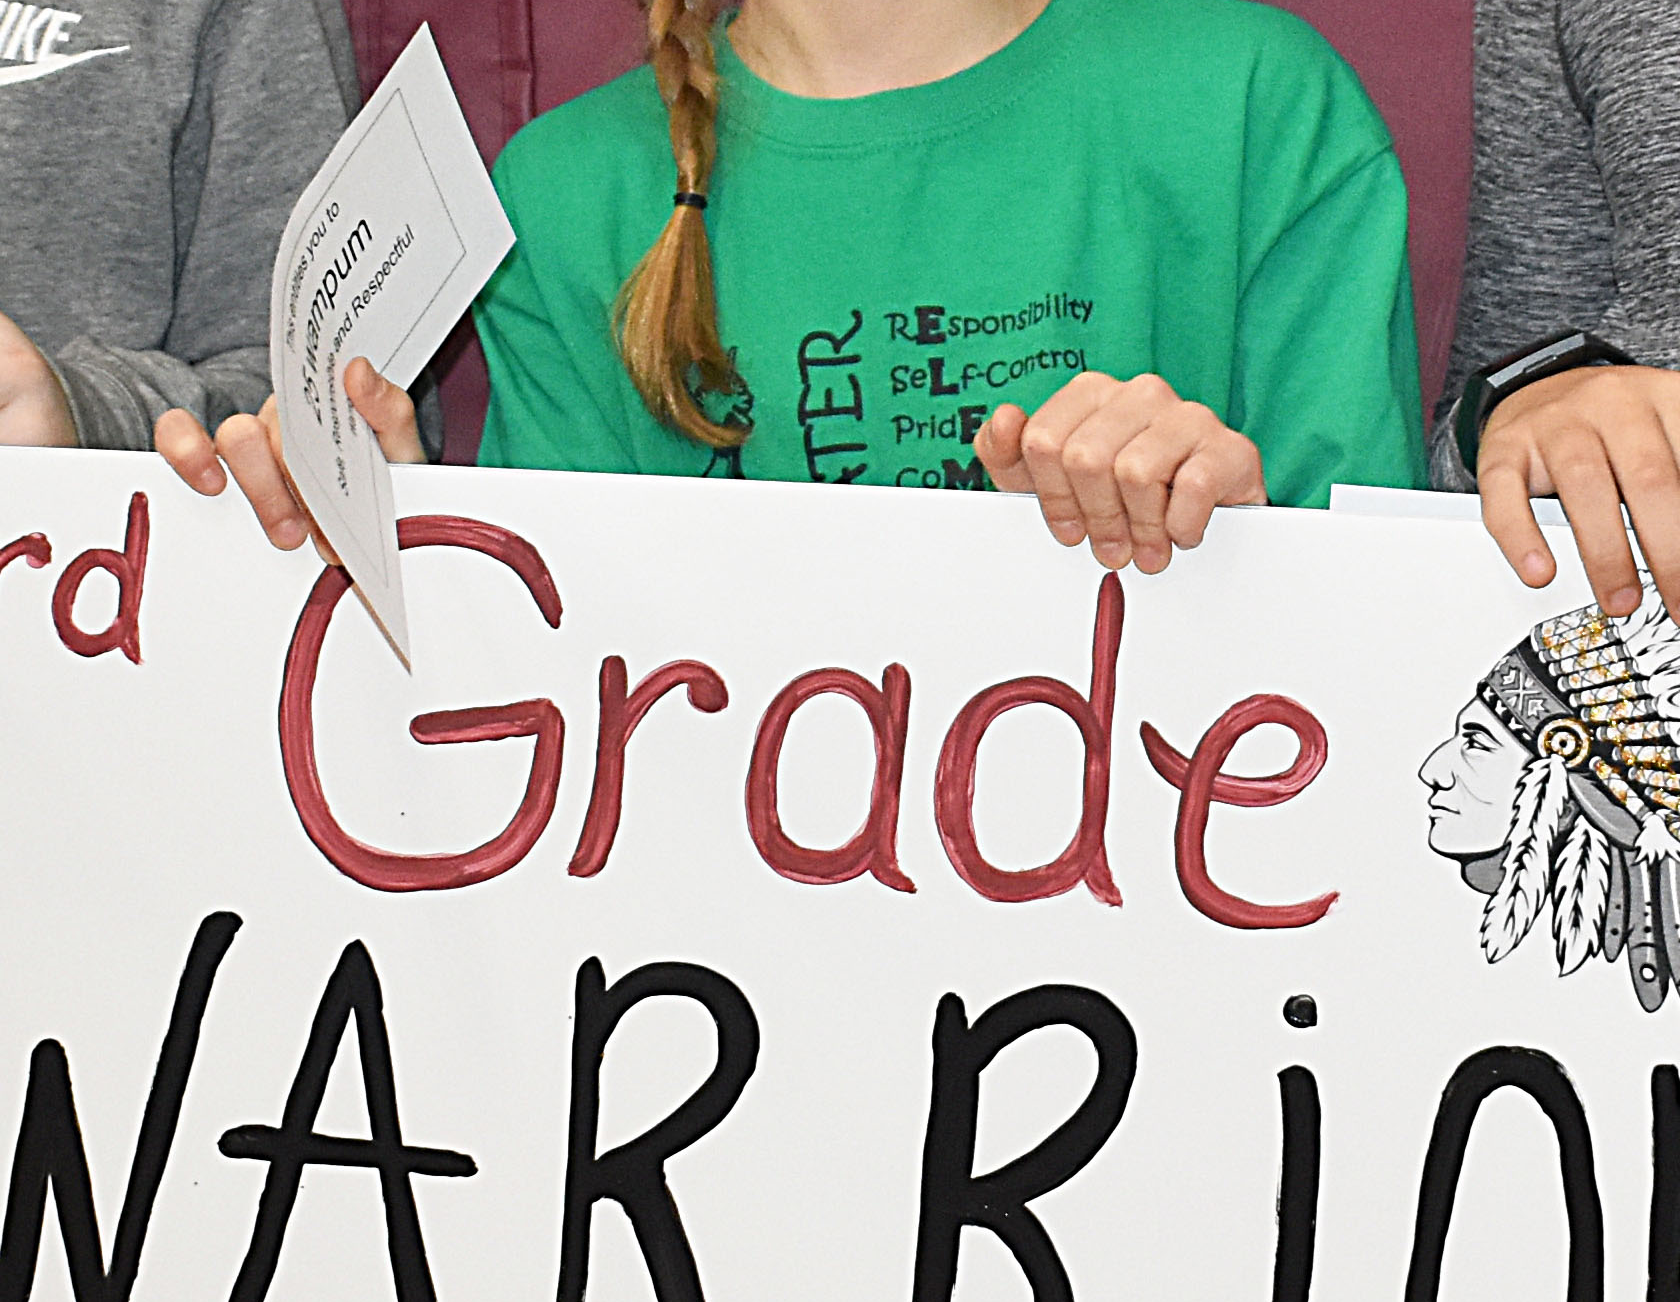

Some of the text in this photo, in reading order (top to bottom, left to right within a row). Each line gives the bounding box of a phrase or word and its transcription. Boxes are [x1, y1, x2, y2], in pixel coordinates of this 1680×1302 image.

[304, 219, 373, 373] wampum
[305, 220, 327, 261] you
[326, 201, 340, 219] to
[333, 314, 353, 352] and
[351, 223, 415, 318] Respectful
[278, 514, 1340, 930] Grade
